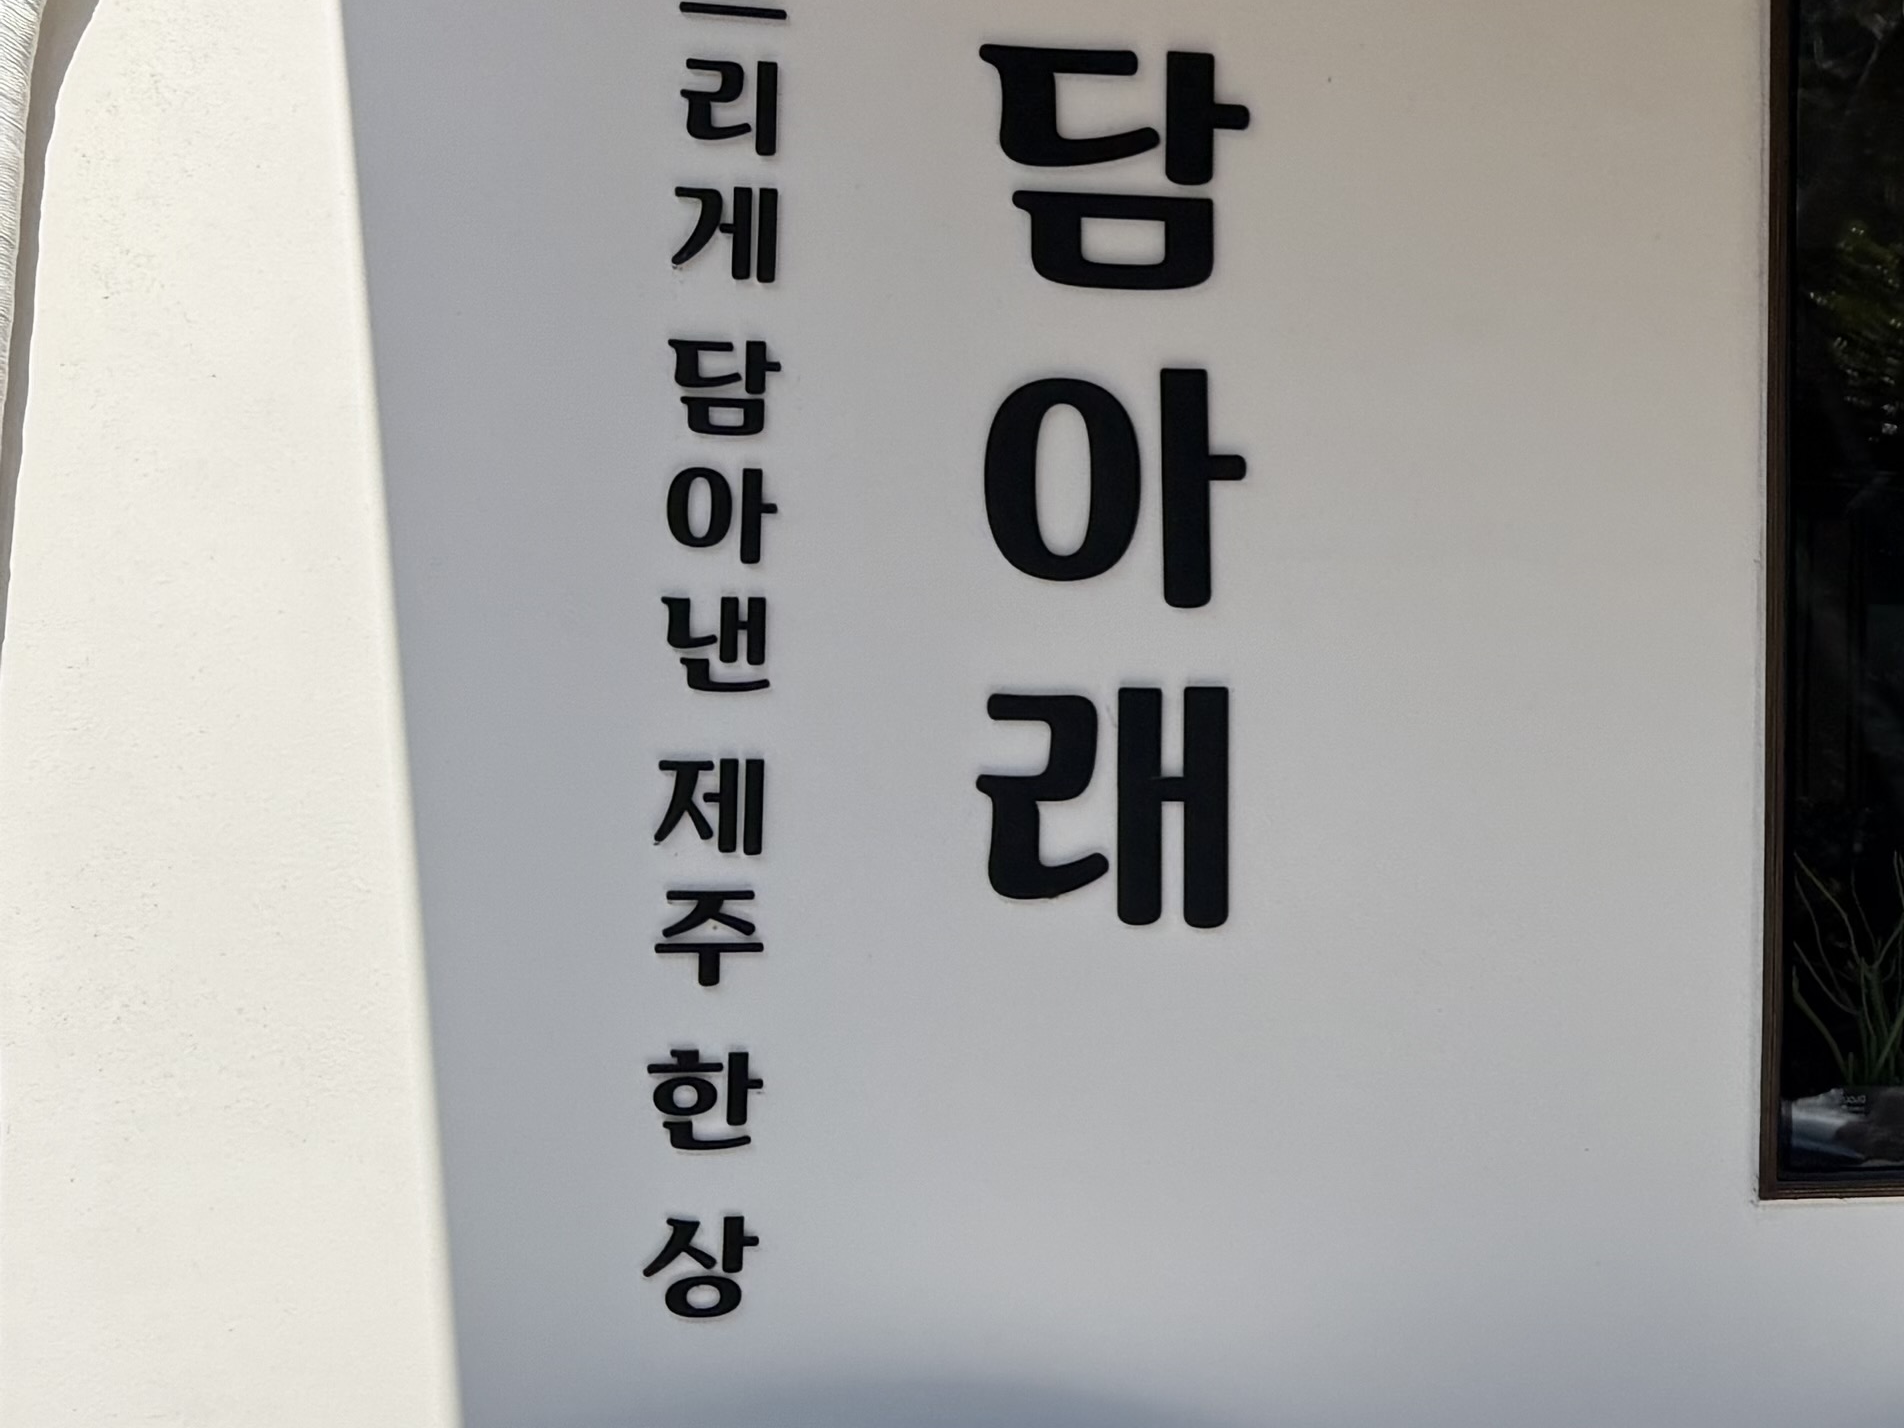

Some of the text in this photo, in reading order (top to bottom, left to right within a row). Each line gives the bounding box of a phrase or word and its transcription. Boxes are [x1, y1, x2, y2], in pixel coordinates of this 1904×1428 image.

[660, 338, 782, 693] 담아낸
[975, 42, 1251, 930] 담아래
[653, 756, 765, 988] 제주
